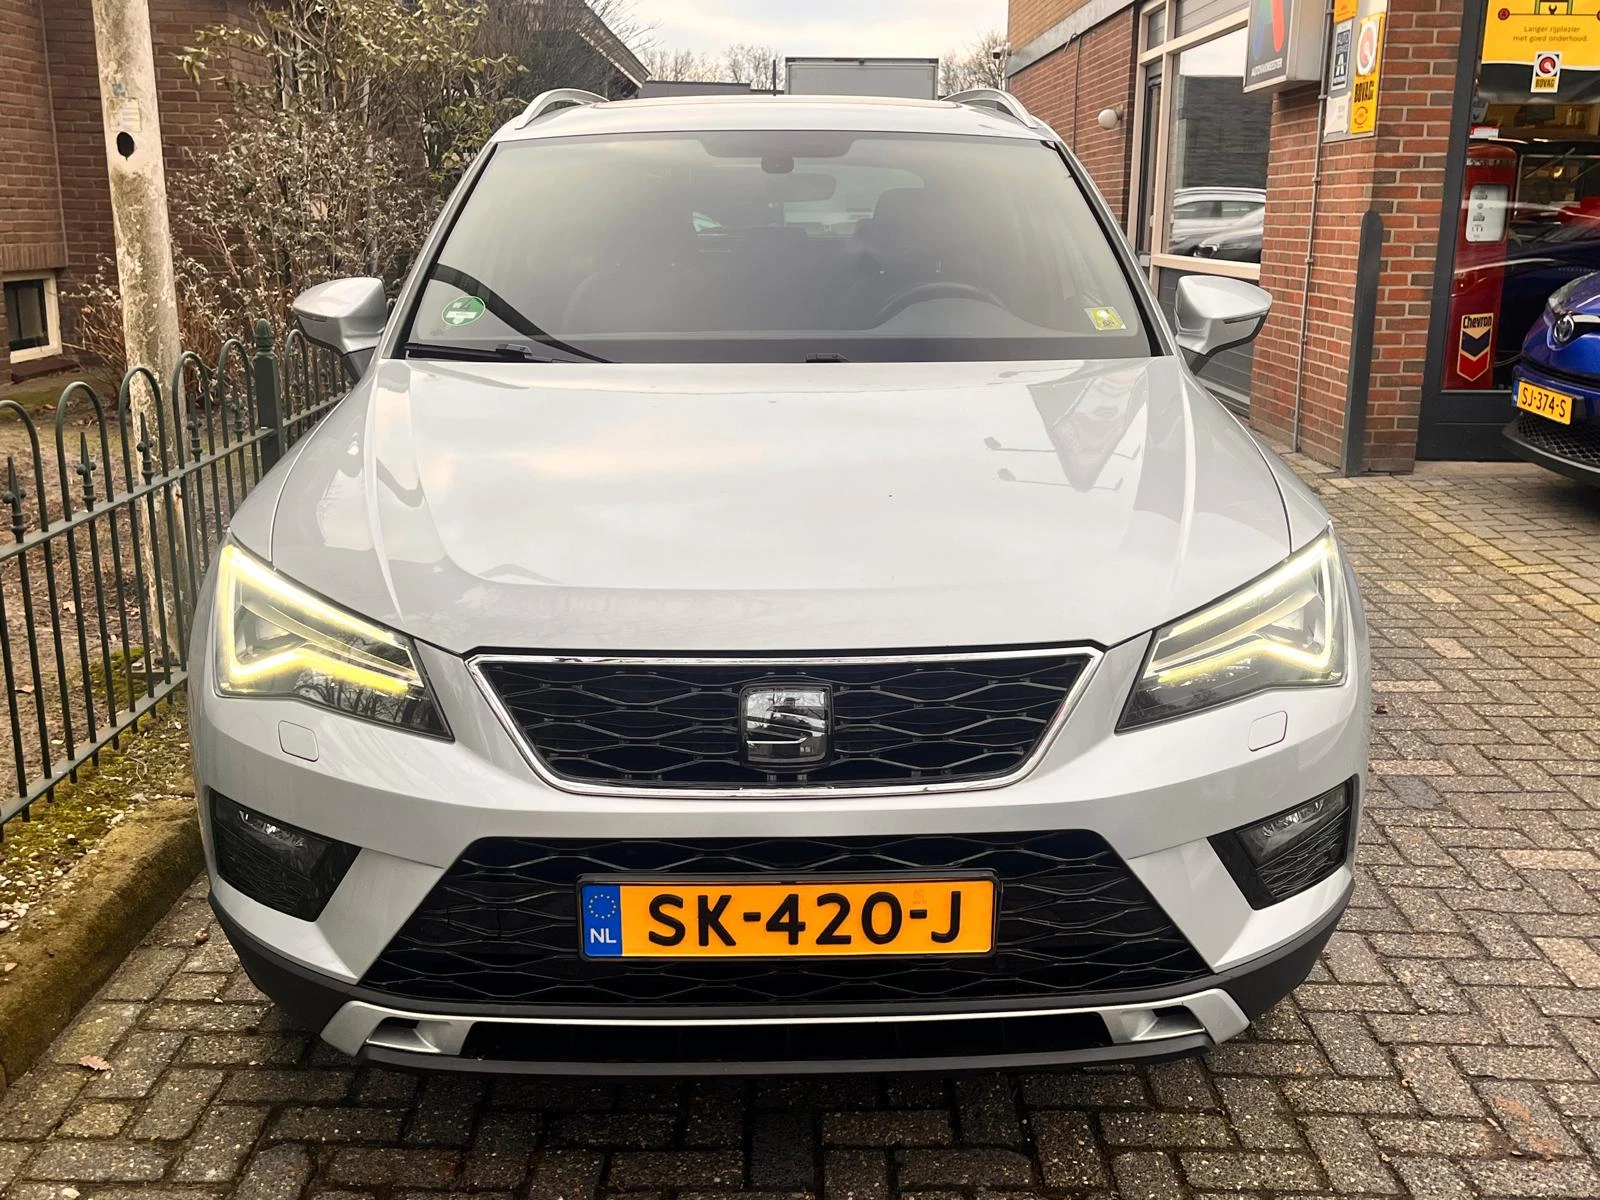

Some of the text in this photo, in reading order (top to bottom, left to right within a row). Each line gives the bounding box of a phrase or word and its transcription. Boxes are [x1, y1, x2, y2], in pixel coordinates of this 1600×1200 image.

[1523, 26, 1581, 34] Langer rijplezier
[1529, 35, 1547, 43] goed
[1535, 79, 1556, 89] BOVAG
[1354, 80, 1375, 103] BOVAG
[1462, 315, 1492, 329] Chevron
[1521, 386, 1567, 418] SJ-374-S
[590, 927, 617, 944] NL
[647, 890, 963, 947] SK-420-J
